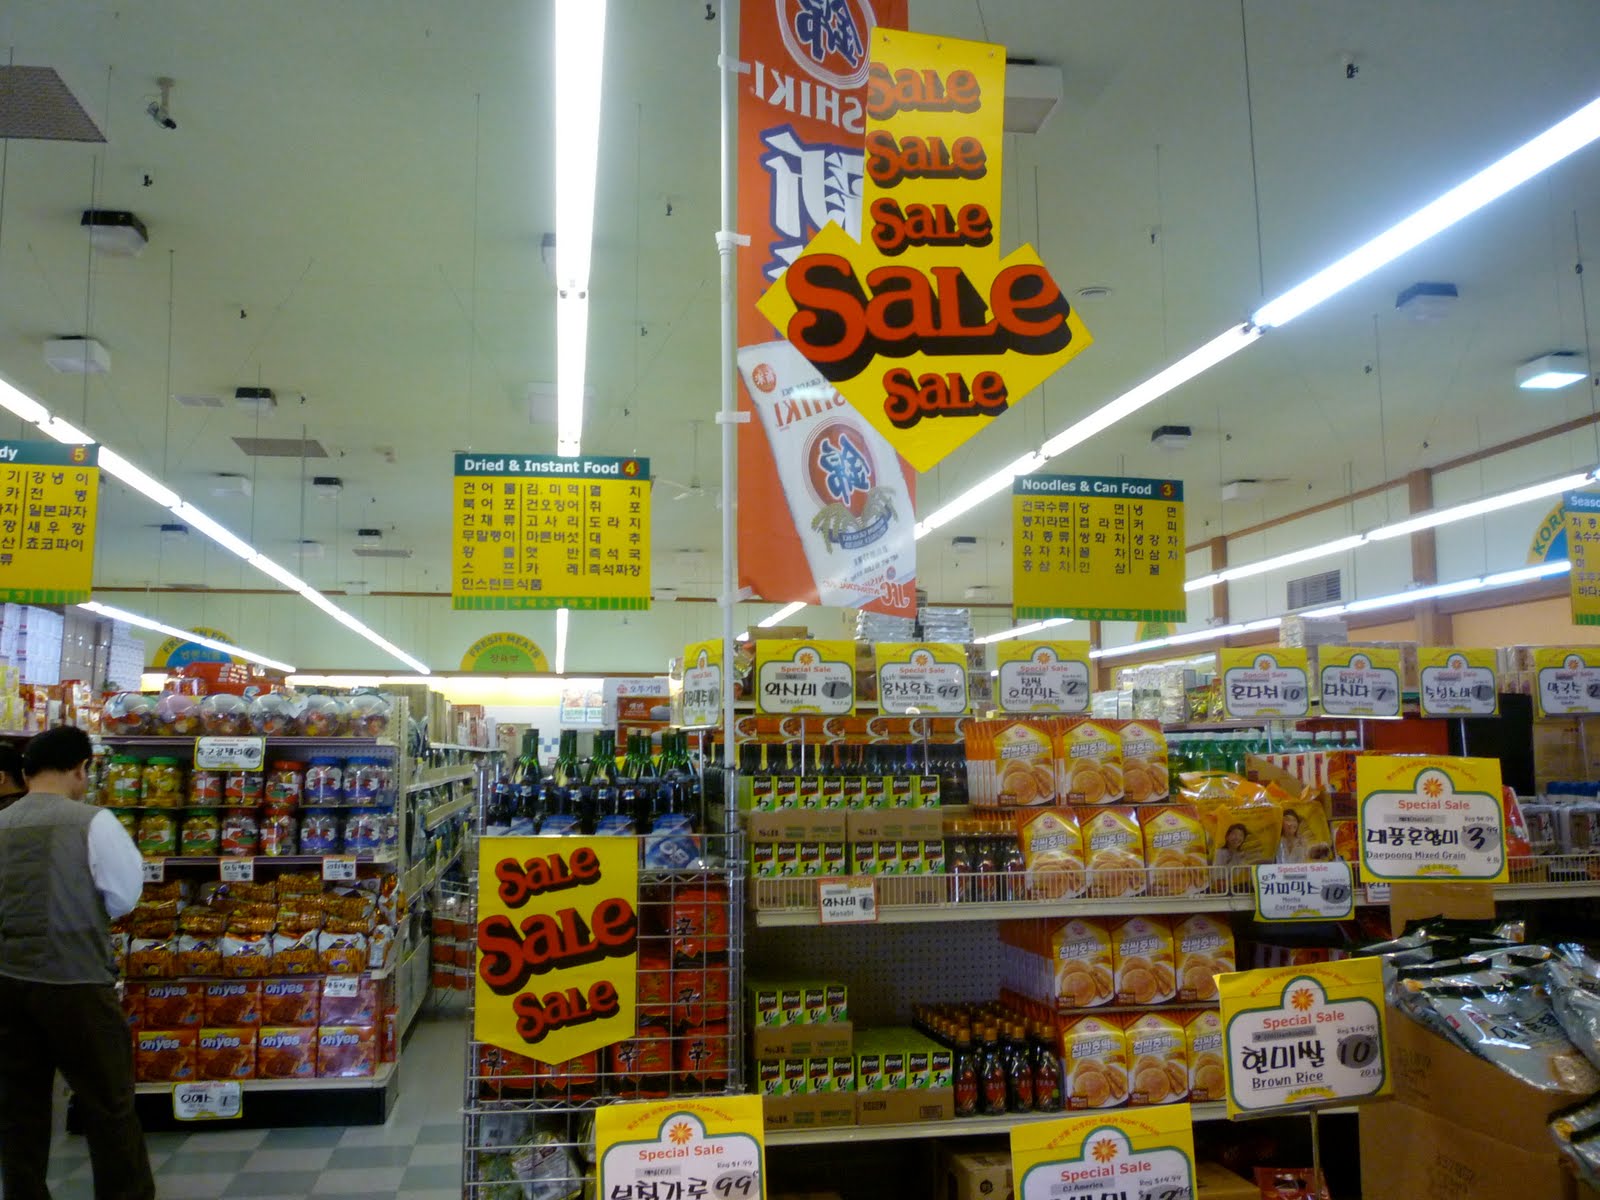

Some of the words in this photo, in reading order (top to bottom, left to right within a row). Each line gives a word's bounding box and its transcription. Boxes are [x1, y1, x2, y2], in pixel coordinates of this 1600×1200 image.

[870, 197, 993, 257] Sale
[785, 253, 1072, 382] Sale
[882, 367, 1008, 429] Sale
[74, 448, 86, 462] 5
[464, 459, 504, 472] Dried
[509, 460, 520, 472] &
[524, 460, 579, 473] Instant
[584, 462, 619, 475] Food
[625, 462, 637, 475] 4
[1022, 479, 1076, 492] Noodles
[1080, 481, 1090, 492] &
[1094, 482, 1118, 494] Can
[1122, 483, 1152, 495] Food
[1163, 484, 1172, 496] 3
[765, 682, 817, 696] 와사비
[1398, 799, 1441, 811] Special
[1445, 800, 1470, 810] Sale
[1367, 826, 1458, 847] 대풍혼합미
[1366, 852, 1412, 860] Daepoong
[1415, 852, 1439, 860] Mixed
[1442, 852, 1466, 860] Grain
[494, 847, 602, 909] Sale
[1278, 866, 1308, 874] Special
[1261, 881, 1321, 896] 커피믹스
[477, 897, 638, 996] Sale
[512, 980, 620, 1045] Sale
[1263, 1014, 1312, 1030] Special
[1316, 1010, 1344, 1023] Sale
[1241, 1040, 1325, 1074] 현미쌀
[1252, 1076, 1291, 1089] Brown
[1296, 1071, 1323, 1083] Rice
[639, 1146, 689, 1161] Special
[694, 1145, 724, 1156] Sale
[1061, 1164, 1115, 1182] Special
[1120, 1161, 1152, 1174] Sale
